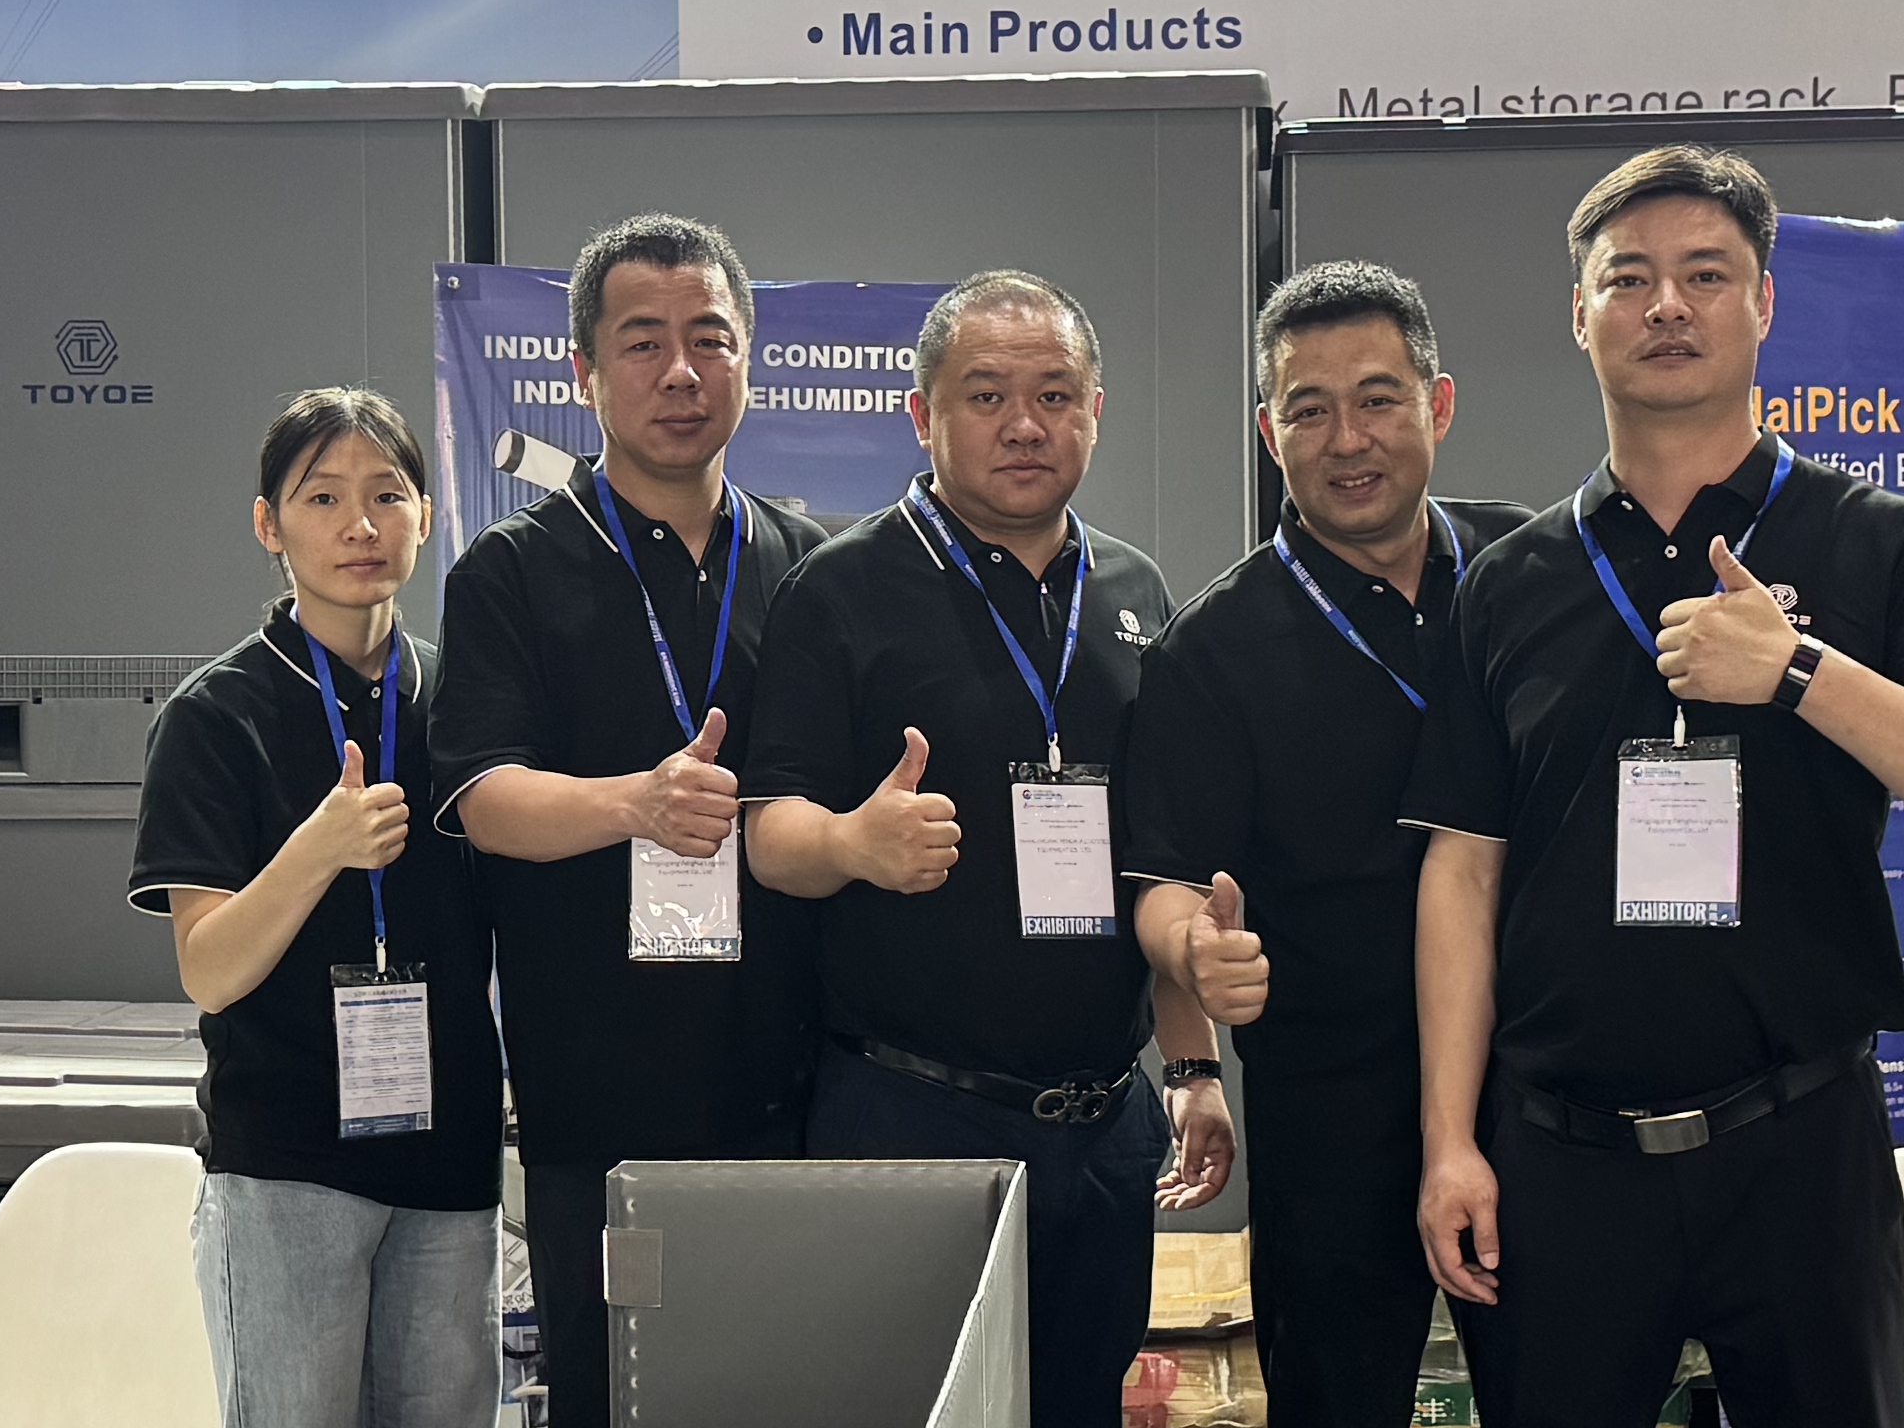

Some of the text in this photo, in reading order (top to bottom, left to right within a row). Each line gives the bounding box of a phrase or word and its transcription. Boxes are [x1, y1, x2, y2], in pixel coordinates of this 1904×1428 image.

[842, 6, 1243, 56] Main Products
[22, 383, 154, 405] TOYOE
[1622, 902, 1708, 921] EXHIBITOR
[1026, 917, 1094, 936] EXHIBITOR
